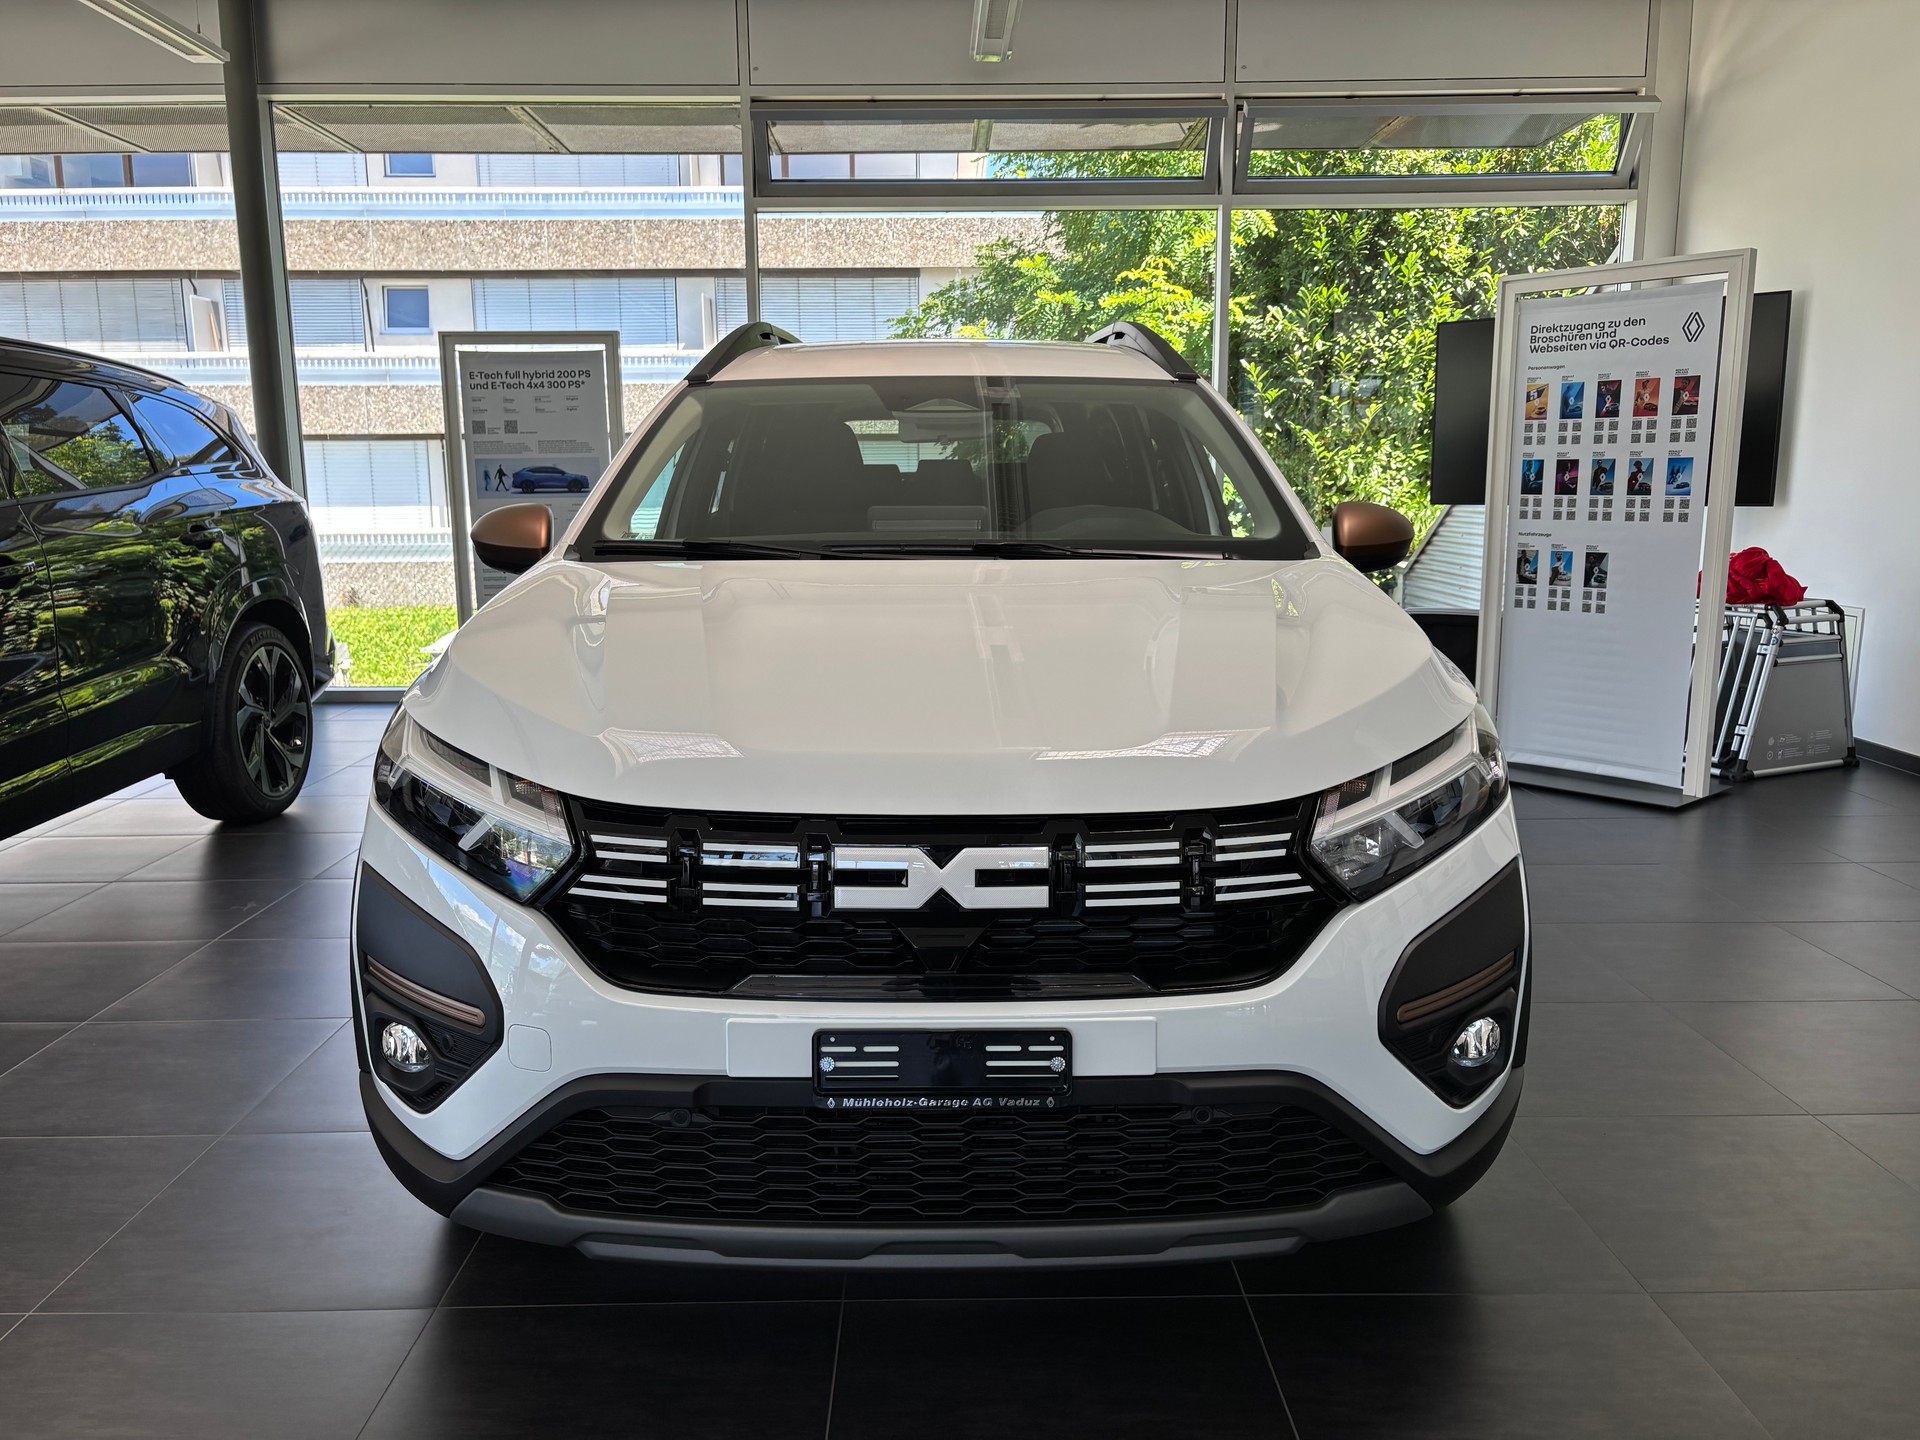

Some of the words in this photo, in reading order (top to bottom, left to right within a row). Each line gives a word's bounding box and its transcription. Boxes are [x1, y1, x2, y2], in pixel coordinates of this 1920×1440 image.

[1530, 320, 1606, 335] Direktzugang
[1607, 319, 1622, 329] zu
[1623, 316, 1646, 327] den
[1529, 330, 1593, 344] Broschüren
[1595, 328, 1617, 340] und
[1529, 341, 1588, 354] Webseiten
[1589, 340, 1607, 351] via
[1609, 335, 1670, 350] QR-Codes
[469, 371, 503, 380] E-Tech
[504, 370, 521, 379] full
[522, 369, 555, 382] hybrid
[557, 369, 577, 378] 200
[578, 369, 591, 378] PS
[469, 381, 489, 390] und
[491, 381, 524, 390] E-Tech
[526, 381, 545, 390] 4x4
[547, 381, 566, 389] 300
[842, 1097, 970, 1108] Mühleholz-Garage
[972, 1097, 993, 1107] AG
[998, 1097, 1041, 1107] Vaduz
